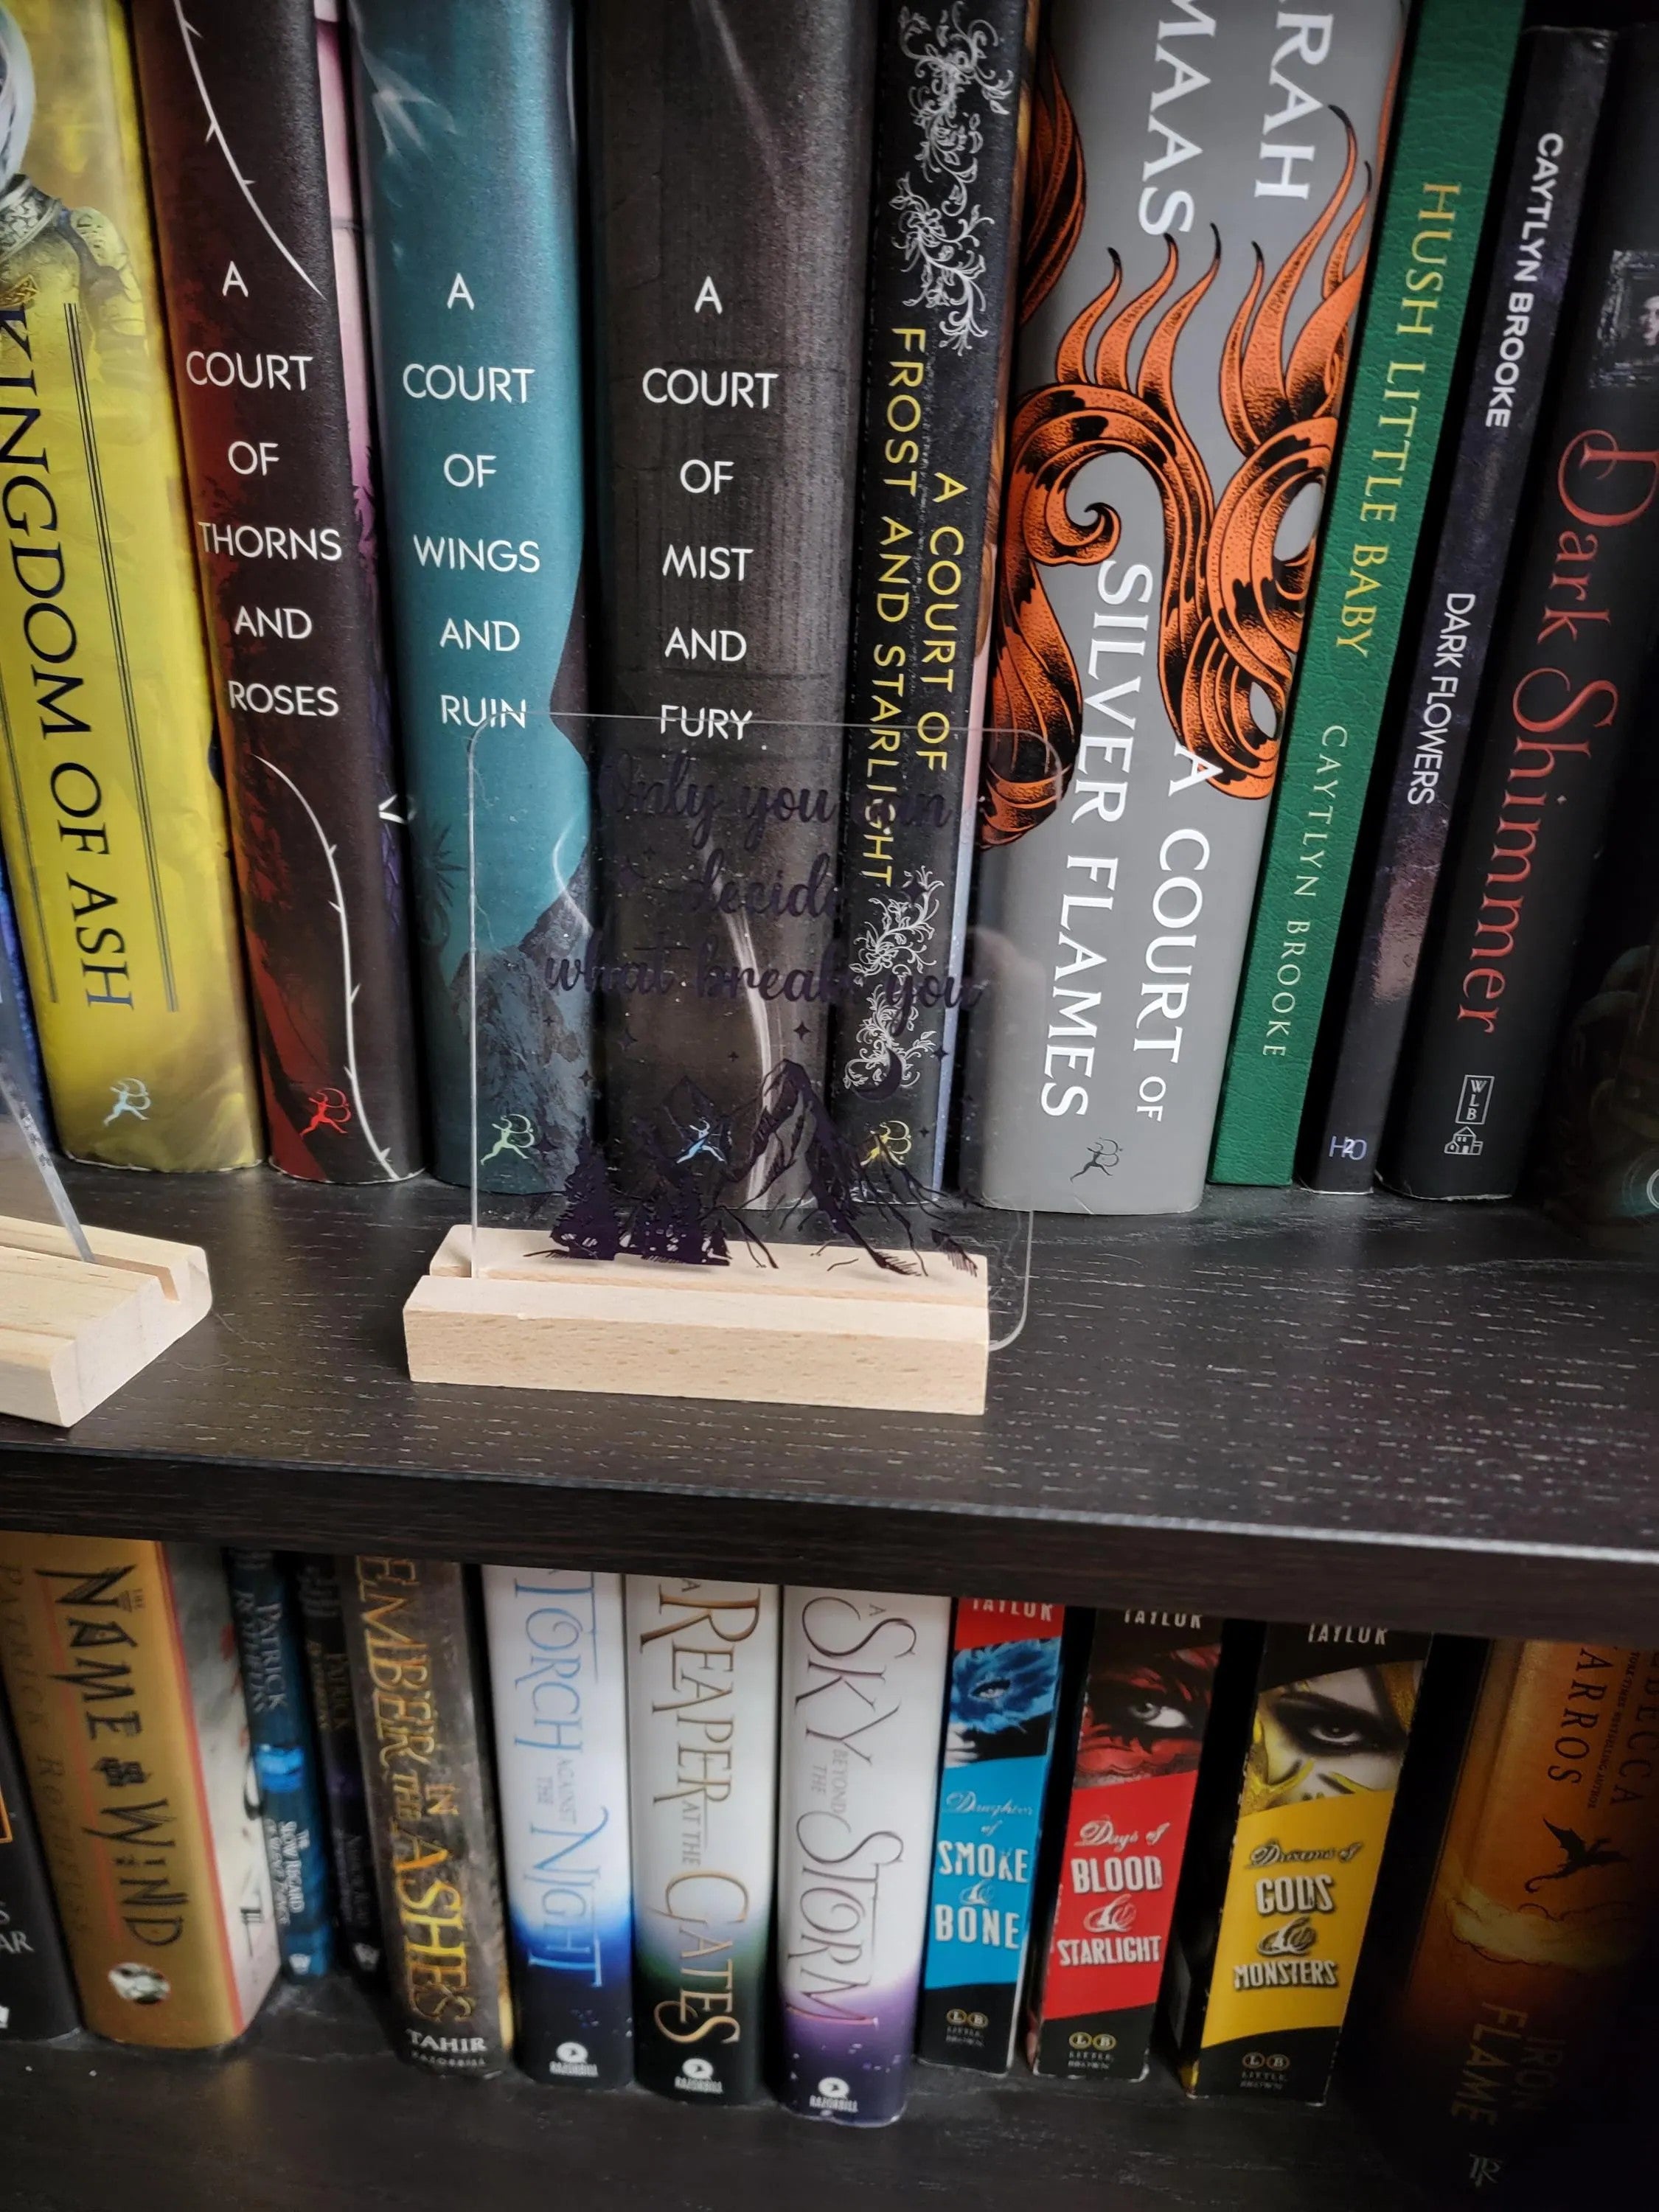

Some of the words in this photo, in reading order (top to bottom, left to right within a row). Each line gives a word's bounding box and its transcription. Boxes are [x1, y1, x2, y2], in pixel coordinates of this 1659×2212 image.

[1254, 0, 1334, 200] RAH
[1514, 132, 1564, 282] CAYTLYN
[222, 261, 249, 297] A
[446, 273, 475, 310] A
[694, 276, 723, 316] A
[1395, 181, 1462, 338] HUSH
[186, 350, 314, 392] COURT
[402, 363, 535, 404] COURT
[642, 368, 779, 410] COURT
[1485, 292, 1534, 429] BROOKE
[885, 327, 926, 498] FROST
[1360, 361, 1427, 524] LITTLE
[227, 440, 280, 476] OF
[443, 452, 498, 488] OF
[679, 459, 734, 495] OF
[931, 471, 969, 504] A
[197, 521, 343, 562] THORNS
[412, 533, 541, 574] WINGS
[661, 544, 754, 581] MIST
[875, 516, 914, 625] AND
[1537, 428, 1659, 644] Dark
[234, 607, 313, 640] AND
[439, 618, 521, 652] AND
[918, 525, 965, 695] COURT
[1335, 543, 1388, 658] BABY
[1431, 593, 1476, 669] DARK
[664, 627, 747, 662] AND
[228, 680, 339, 717] ROSES
[441, 695, 526, 729] RUIN
[660, 703, 753, 741] FURY
[1071, 560, 1154, 824] SILVER
[860, 644, 906, 888] STARLIGHT
[917, 709, 950, 772] OF
[1168, 740, 1224, 797] A
[1407, 676, 1457, 806] FLOWERS
[49, 761, 111, 857] OF
[739, 785, 838, 851] you
[1295, 724, 1349, 897] CAYTLYN
[1456, 667, 1619, 1034] Shimmer
[67, 872, 135, 1011] ASH
[697, 931, 861, 1003] break
[887, 973, 987, 1037] you
[1133, 828, 1211, 1064] COURT
[1040, 855, 1119, 1116] FLAMES
[1262, 919, 1311, 1057] BROOKE
[1136, 1075, 1167, 1121] OF
[33, 1563, 142, 1739] NAME
[514, 1573, 599, 1755] TORCH
[640, 1584, 761, 1804] REAPER
[794, 1596, 917, 1767] SKY
[1547, 1647, 1613, 1785] ARROS
[83, 1798, 189, 1947] WIND
[938, 1840, 1029, 1883] SMOKE
[1071, 1855, 1163, 1893] BLOOD
[1074, 1815, 1139, 1853] Days
[391, 1816, 473, 2023] ASHES
[522, 1805, 609, 1989] NIGHT
[786, 1811, 905, 2031] STORM
[934, 1904, 1020, 1950] BONE
[1256, 1874, 1335, 1915] GODS
[646, 1871, 749, 2044] GATES
[1057, 1935, 1162, 1966] STARLIGHT
[1234, 1958, 1338, 1991] MONSTERS
[405, 2028, 487, 2053] TAHIR
[1450, 2001, 1529, 2126] FLAME
